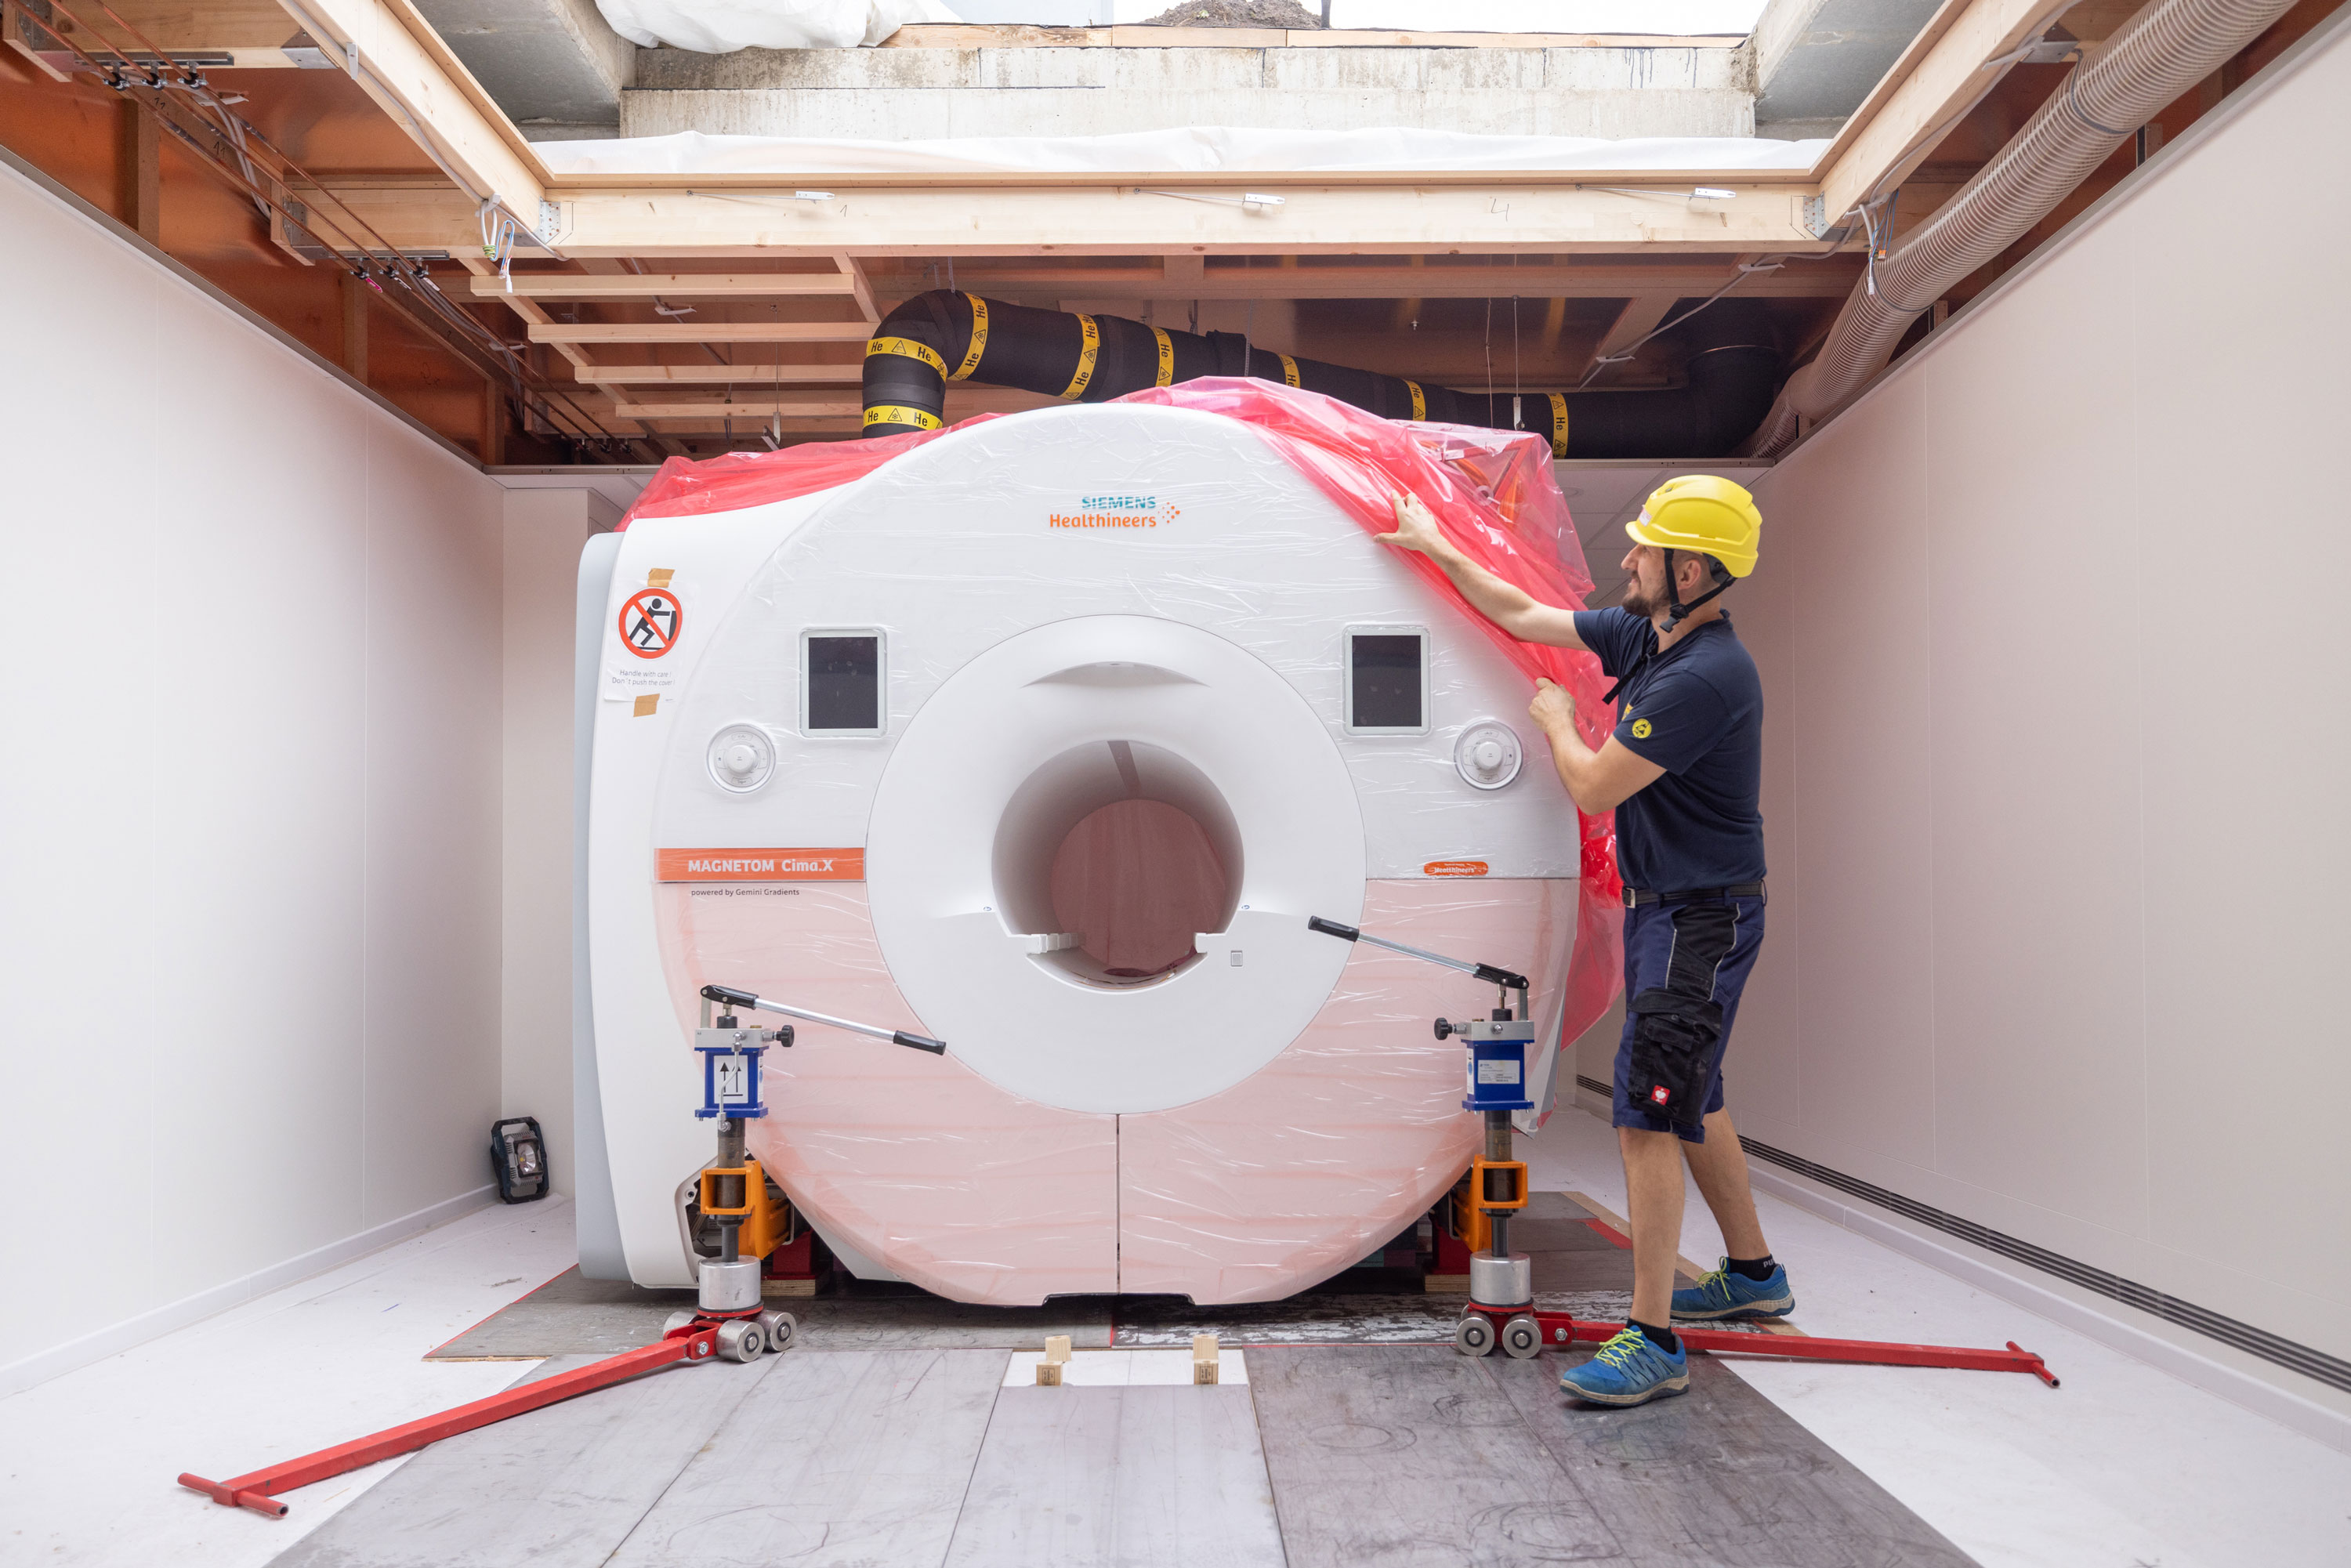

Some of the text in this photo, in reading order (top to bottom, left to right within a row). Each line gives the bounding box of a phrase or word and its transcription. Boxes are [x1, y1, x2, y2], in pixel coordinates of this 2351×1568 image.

[976, 304, 986, 319] He
[1085, 325, 1096, 339] He
[871, 341, 883, 353] He
[917, 346, 932, 362] He
[1160, 343, 1170, 358] He
[965, 353, 980, 367] He
[1074, 371, 1089, 386] He
[1411, 386, 1421, 399] He
[868, 411, 879, 423] He
[914, 411, 928, 427] He
[1556, 417, 1566, 431] He
[1081, 496, 1156, 509] SIEMENS
[1049, 512, 1157, 528] Healthineers
[687, 859, 834, 872] MAGNETOM Cima.X
[691, 889, 723, 898] powered
[724, 889, 734, 898] by
